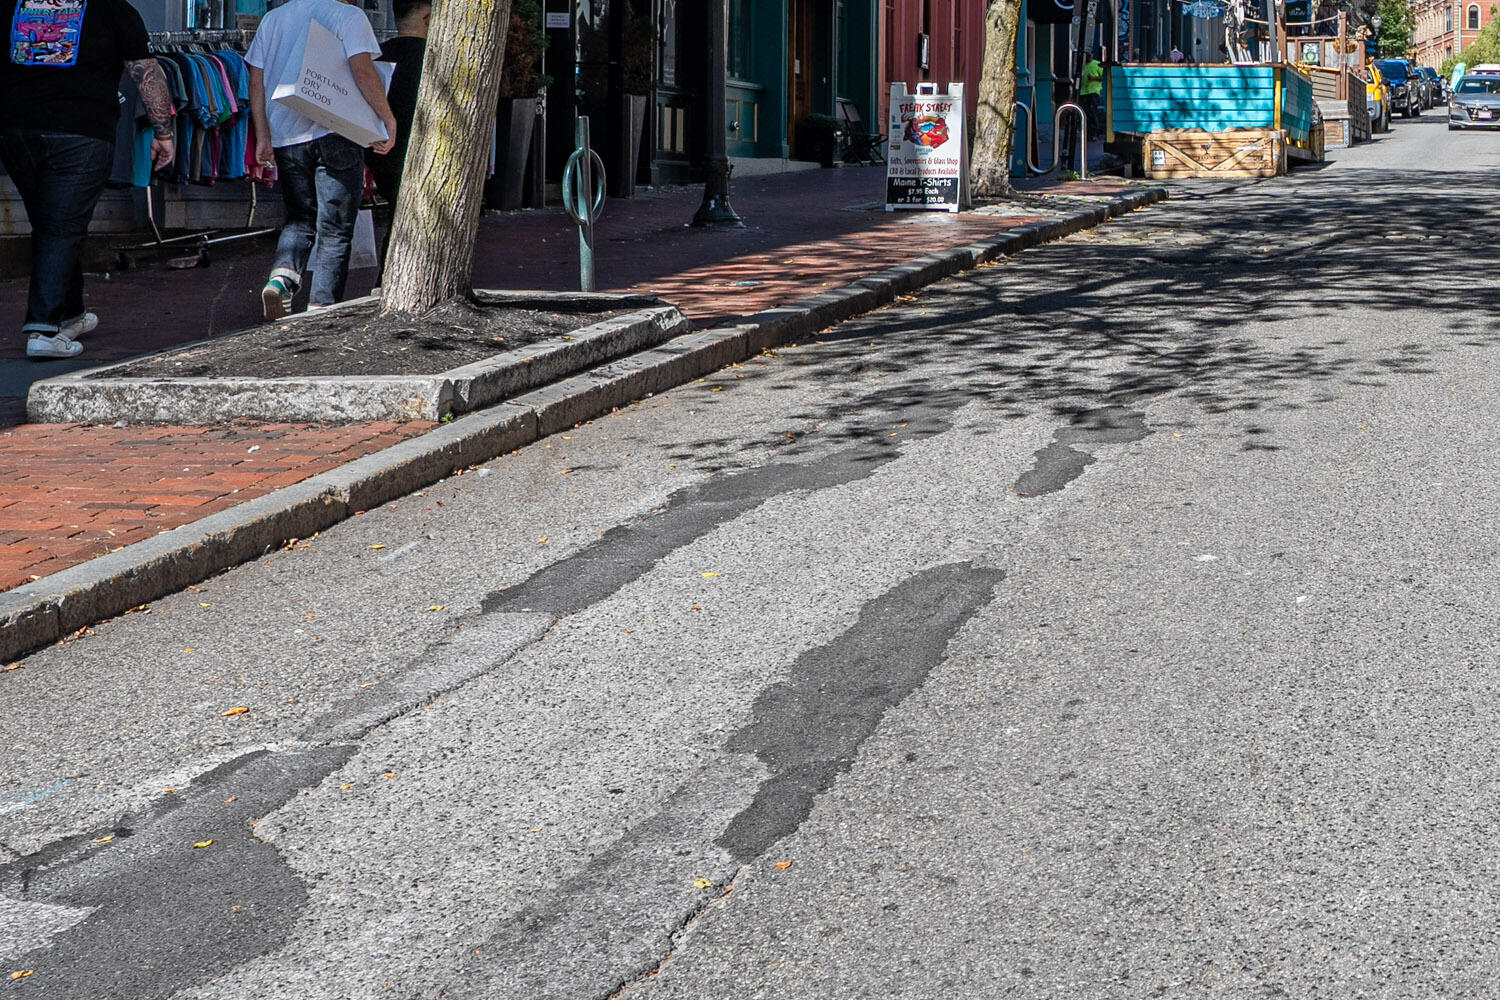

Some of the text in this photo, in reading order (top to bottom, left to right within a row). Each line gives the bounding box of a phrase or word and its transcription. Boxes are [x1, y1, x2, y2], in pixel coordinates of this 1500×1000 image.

[303, 77, 321, 90] DRY
[305, 68, 348, 96] PORTLAND
[300, 86, 332, 106] GOODS
[899, 103, 952, 114] FREAK STREET
[934, 156, 946, 165] Glass
[946, 156, 958, 167] Shop
[904, 166, 916, 175] Local
[918, 166, 937, 175] Products
[938, 166, 958, 176] Available
[892, 178, 952, 186] Maine T-Shirts
[908, 188, 922, 196] $7.95
[926, 196, 945, 204] $20.00
